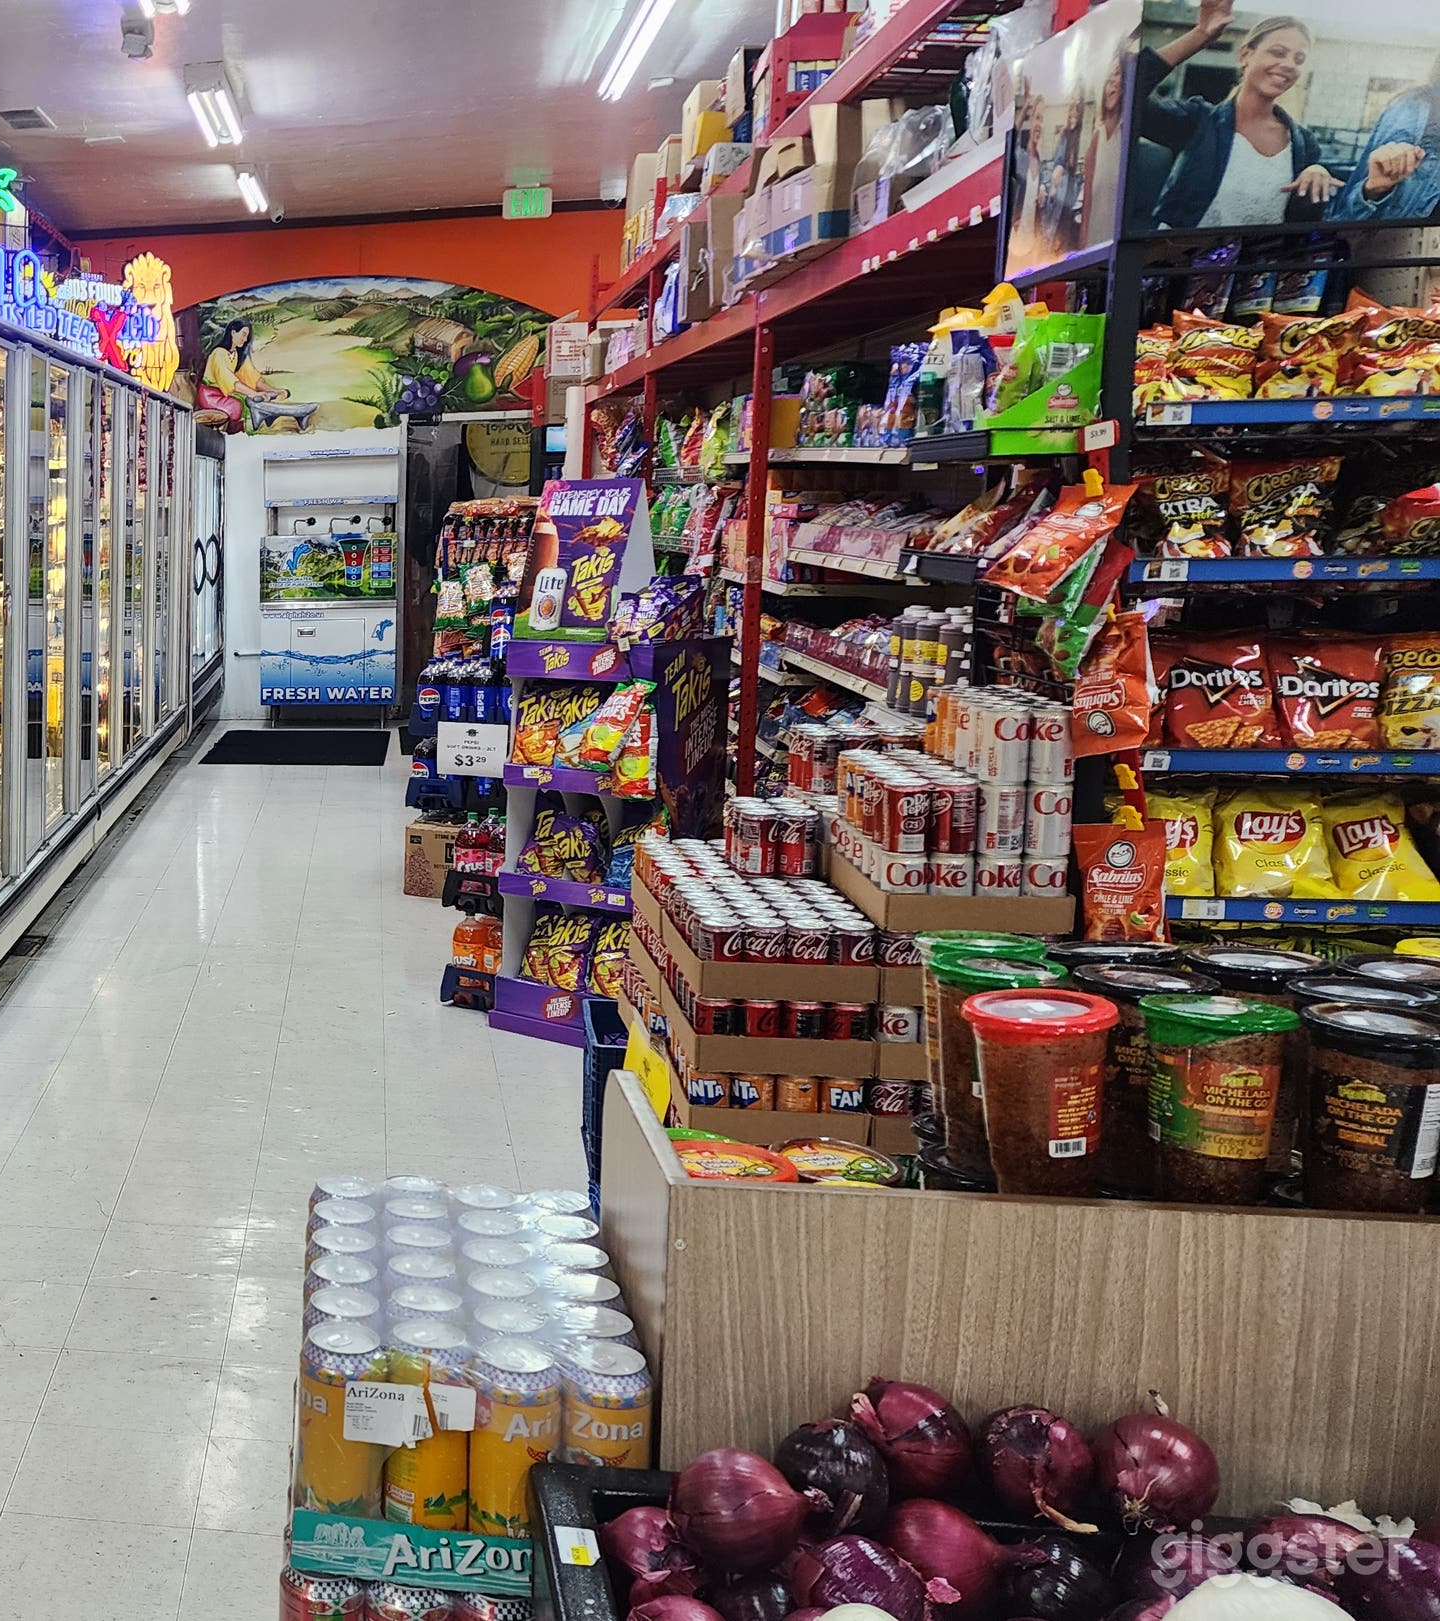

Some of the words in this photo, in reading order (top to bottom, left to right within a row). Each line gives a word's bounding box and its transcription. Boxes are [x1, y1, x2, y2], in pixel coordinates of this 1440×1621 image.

[548, 498, 593, 516] GAME
[595, 496, 631, 516] DAY
[572, 552, 616, 588] Takis
[539, 575, 564, 594] Lite
[543, 652, 570, 674] Takis
[664, 649, 685, 686] TEAM
[1171, 668, 1263, 689] Doritos
[1280, 675, 1380, 699] Doritos
[262, 687, 320, 701] FRESH
[327, 686, 393, 700] WATER
[476, 690, 485, 718] PEPSI
[672, 664, 711, 732] Takis
[1242, 813, 1301, 844] Lay's
[1340, 819, 1397, 854] Lay's
[1255, 858, 1302, 868] Classic
[1357, 863, 1406, 880] Classic
[1202, 1085, 1271, 1098] MICHELADA
[1206, 1095, 1225, 1105] ON
[1230, 1097, 1252, 1107] THE
[1324, 1095, 1404, 1118] MICHELADA
[1376, 1115, 1398, 1126] GO
[346, 1386, 405, 1402] AriZona
[503, 1412, 553, 1442] Ari
[572, 1411, 645, 1442] Zona
